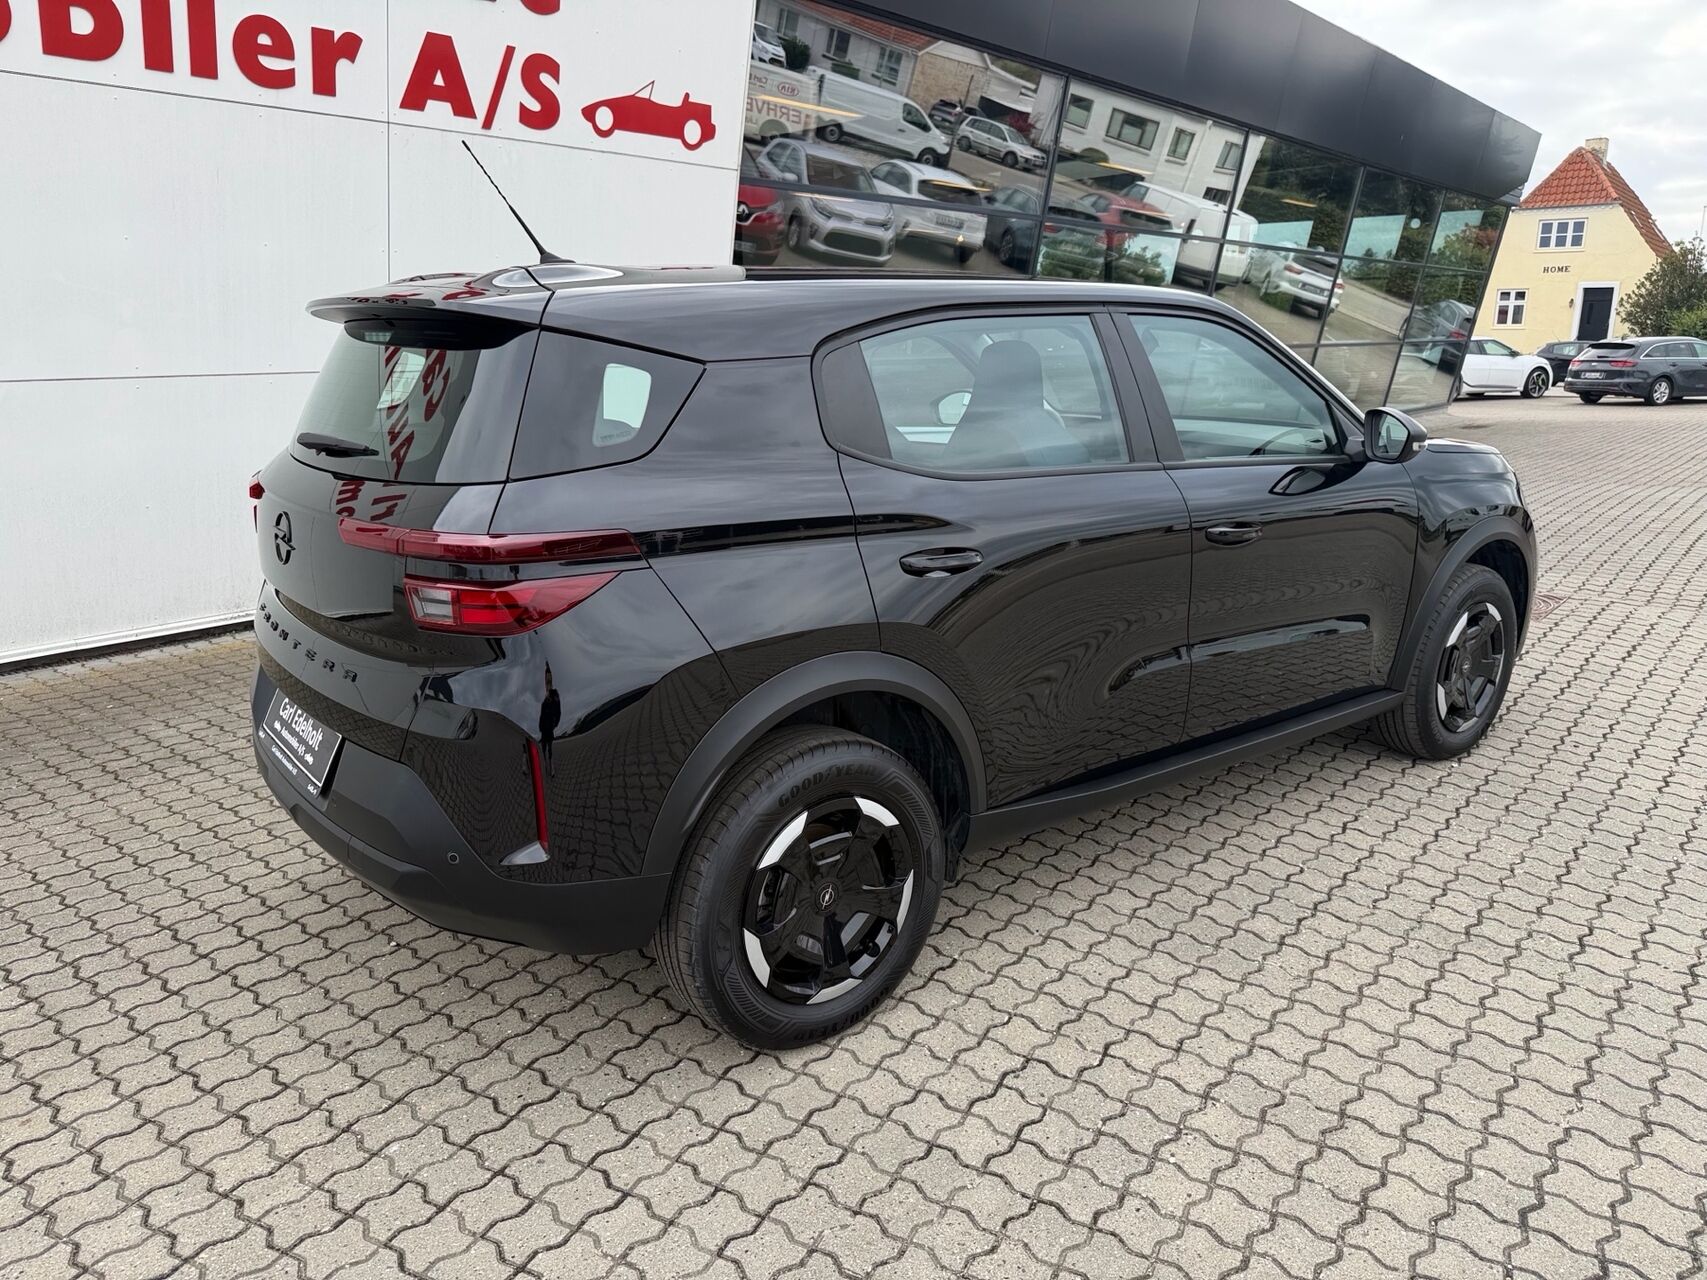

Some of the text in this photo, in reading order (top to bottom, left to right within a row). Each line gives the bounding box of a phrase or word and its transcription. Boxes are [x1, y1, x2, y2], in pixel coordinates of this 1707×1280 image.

[399, 31, 560, 130] A/S
[1543, 265, 1571, 273] HOME
[279, 698, 323, 751] Carl Edelholt
